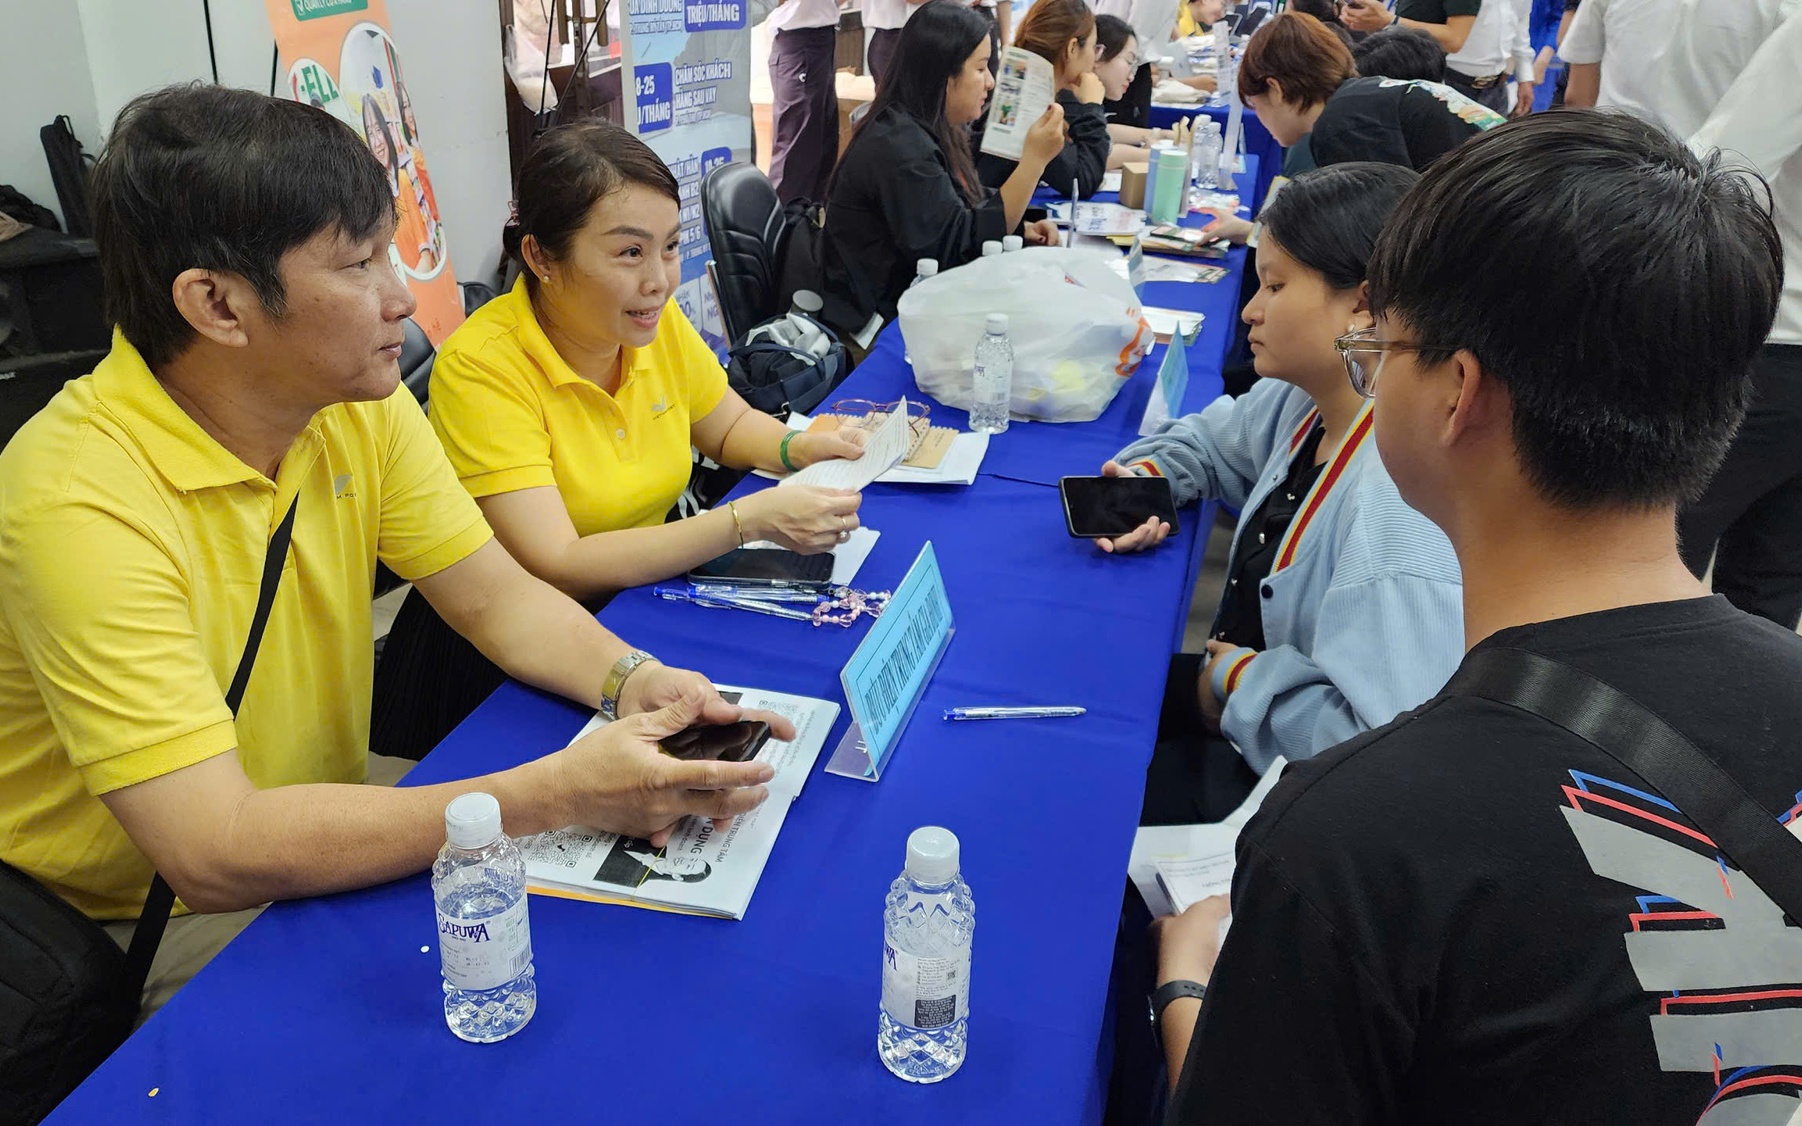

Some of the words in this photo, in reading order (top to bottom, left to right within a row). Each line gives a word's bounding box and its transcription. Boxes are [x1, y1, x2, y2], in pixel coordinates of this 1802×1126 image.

[693, 60, 705, 82] SÓC
[705, 58, 732, 80] KHÁCH
[693, 89, 705, 107] SAU
[705, 86, 717, 104] VAY
[690, 826, 714, 854] DỤNG
[722, 826, 739, 848] TRUNG
